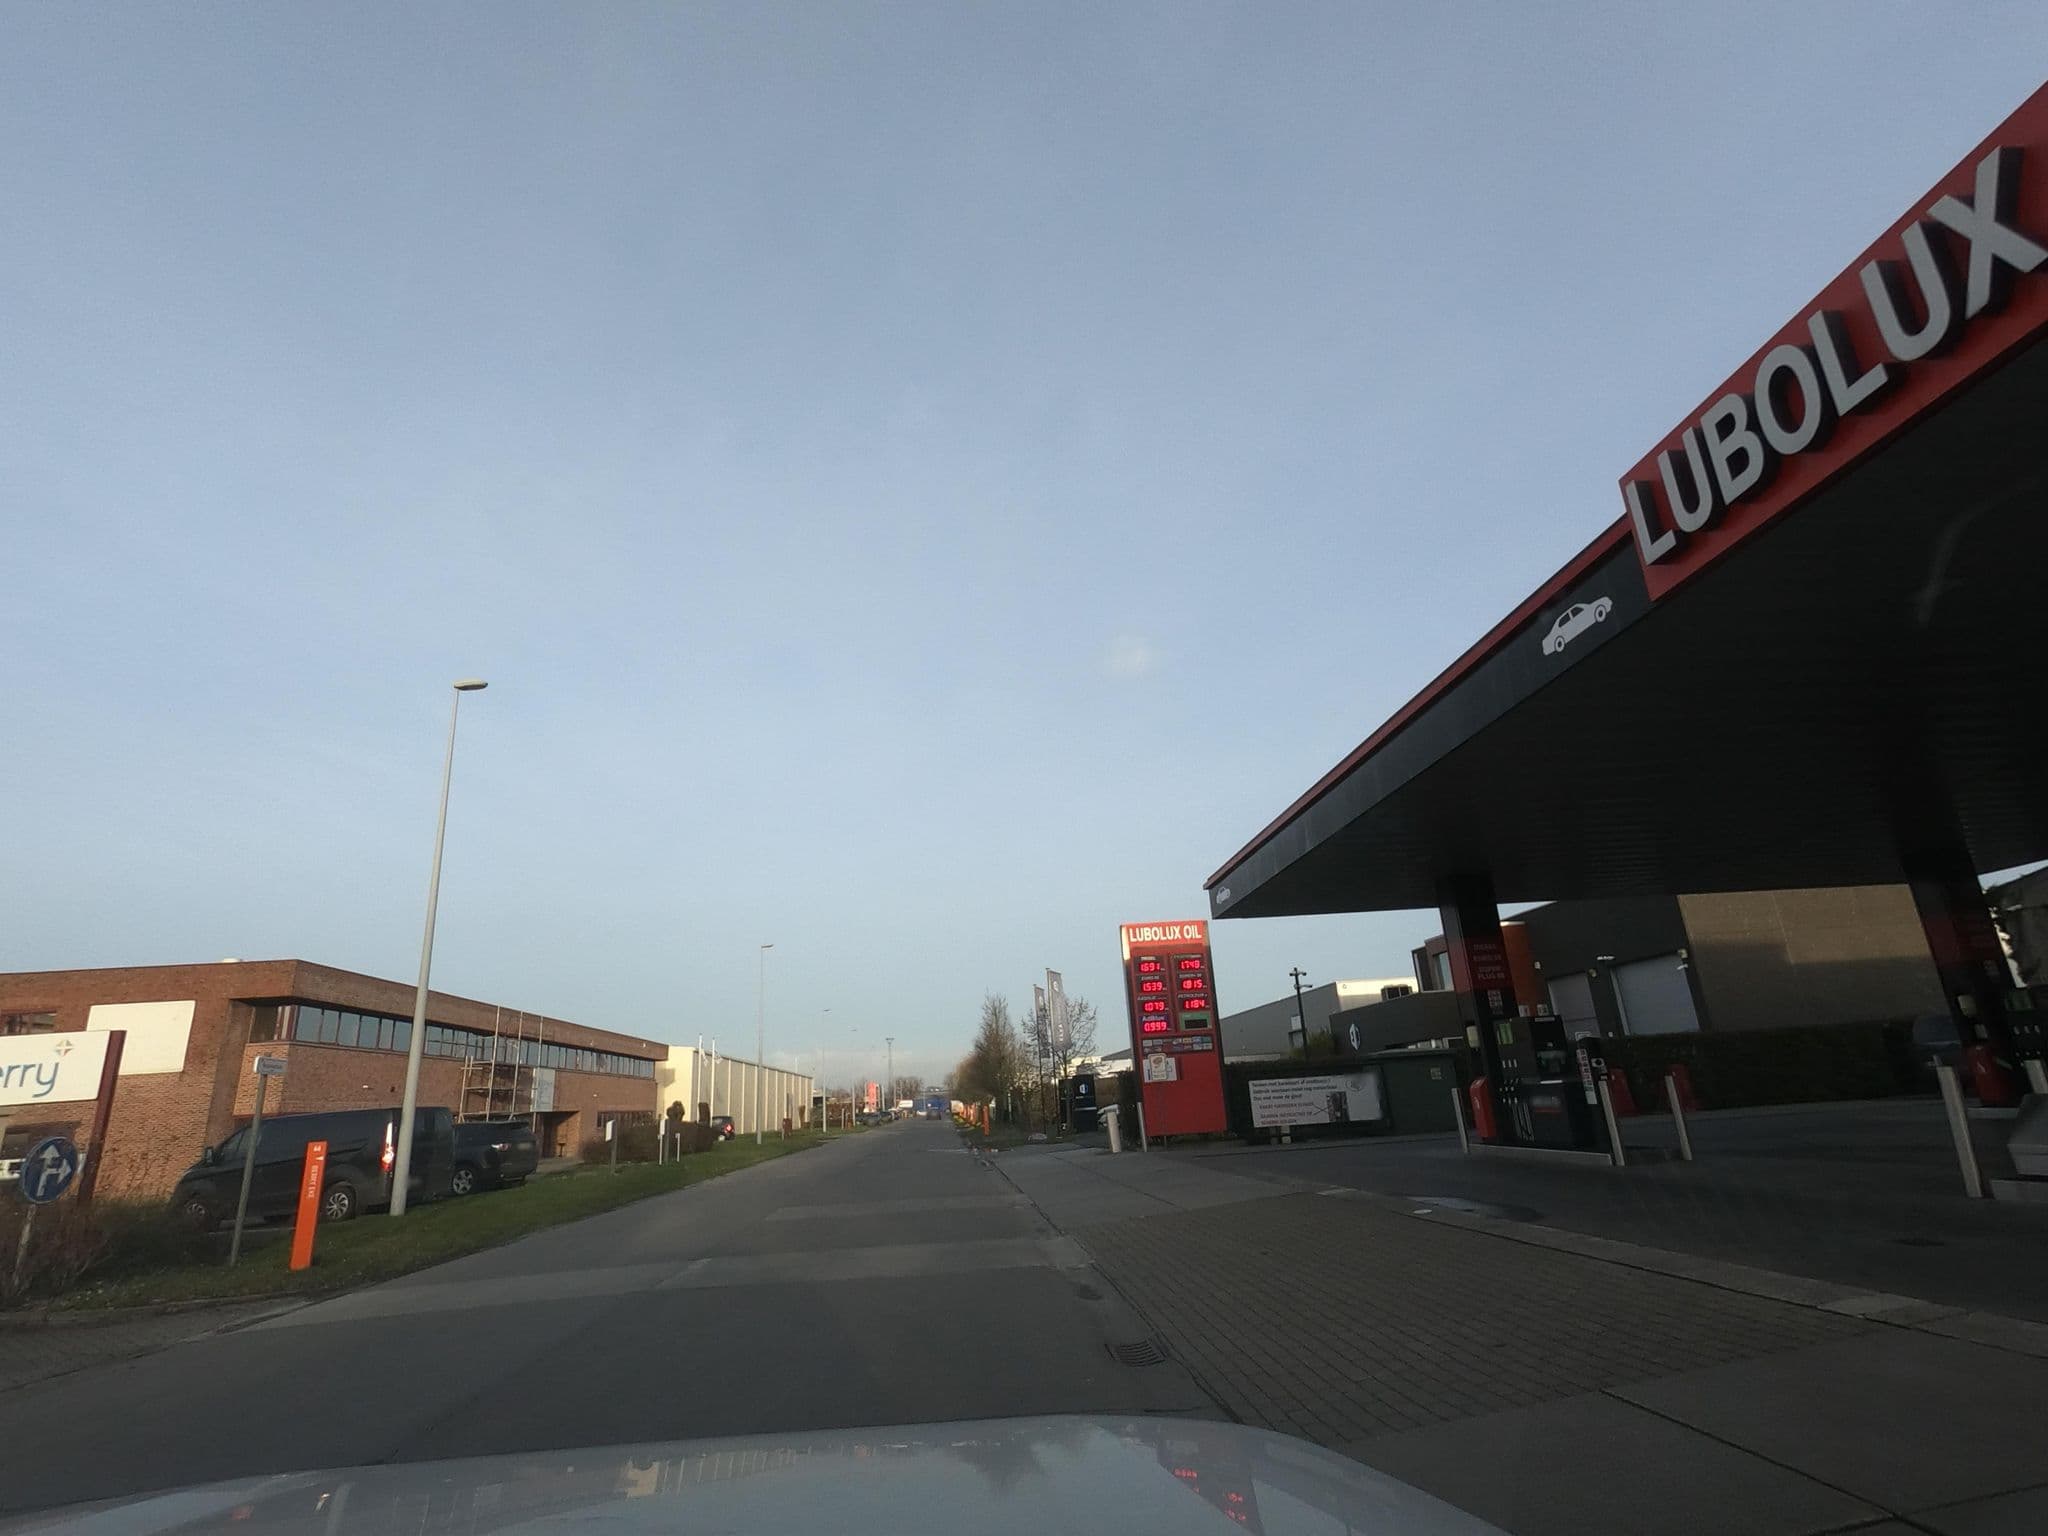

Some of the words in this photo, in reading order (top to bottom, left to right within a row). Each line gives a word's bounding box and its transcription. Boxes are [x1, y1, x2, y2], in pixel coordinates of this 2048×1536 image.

[1626, 145, 2048, 566] LUBOLUX
[1129, 925, 1181, 942] LUBOLUX
[1183, 925, 1202, 939] OIL
[0, 1062, 60, 1098] rry
